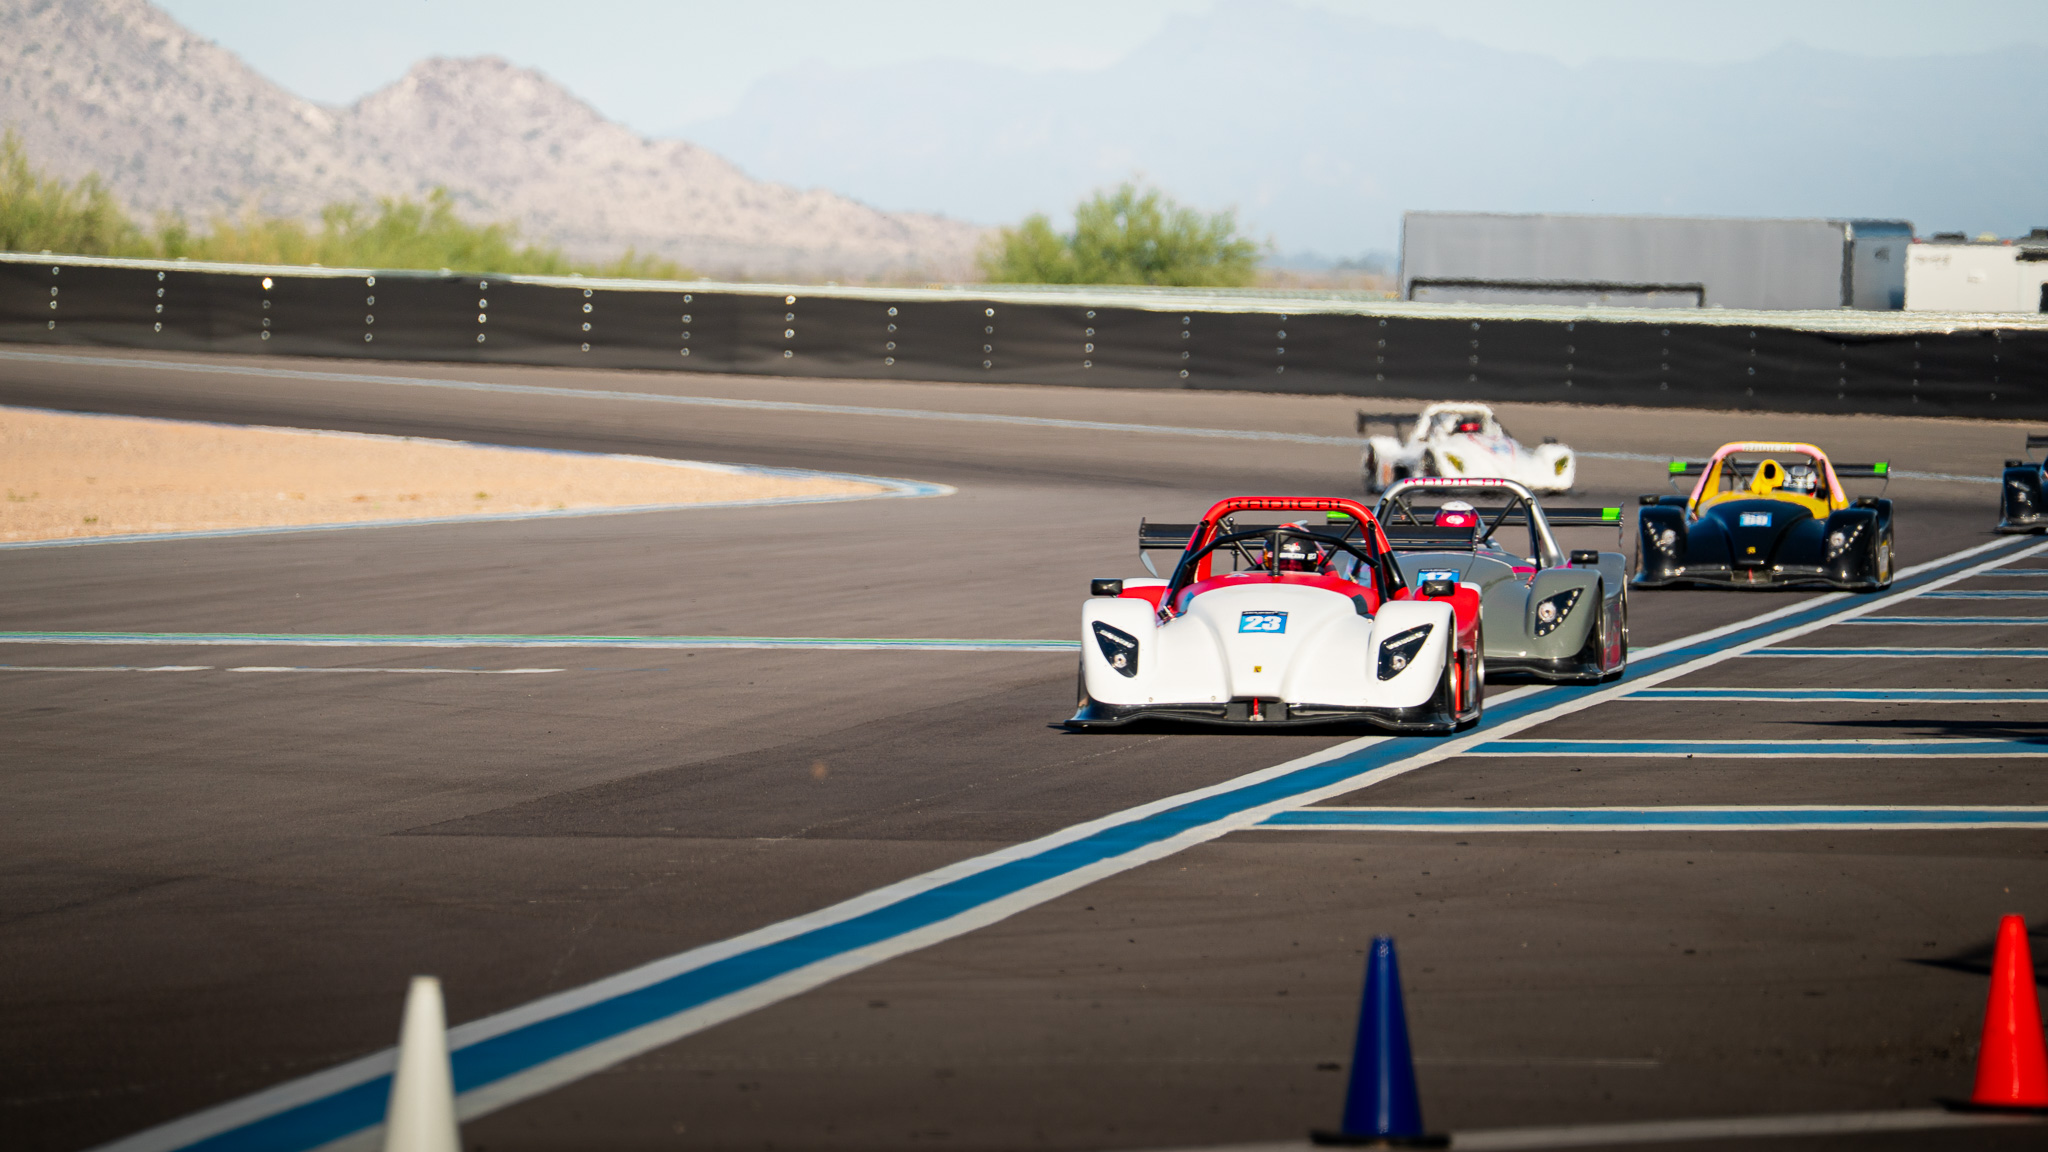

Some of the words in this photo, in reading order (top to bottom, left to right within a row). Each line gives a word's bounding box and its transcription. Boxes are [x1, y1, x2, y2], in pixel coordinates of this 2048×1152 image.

[1404, 478, 1509, 486] RADICAL
[1227, 500, 1350, 509] RADICAL
[1243, 616, 1282, 631] 23
